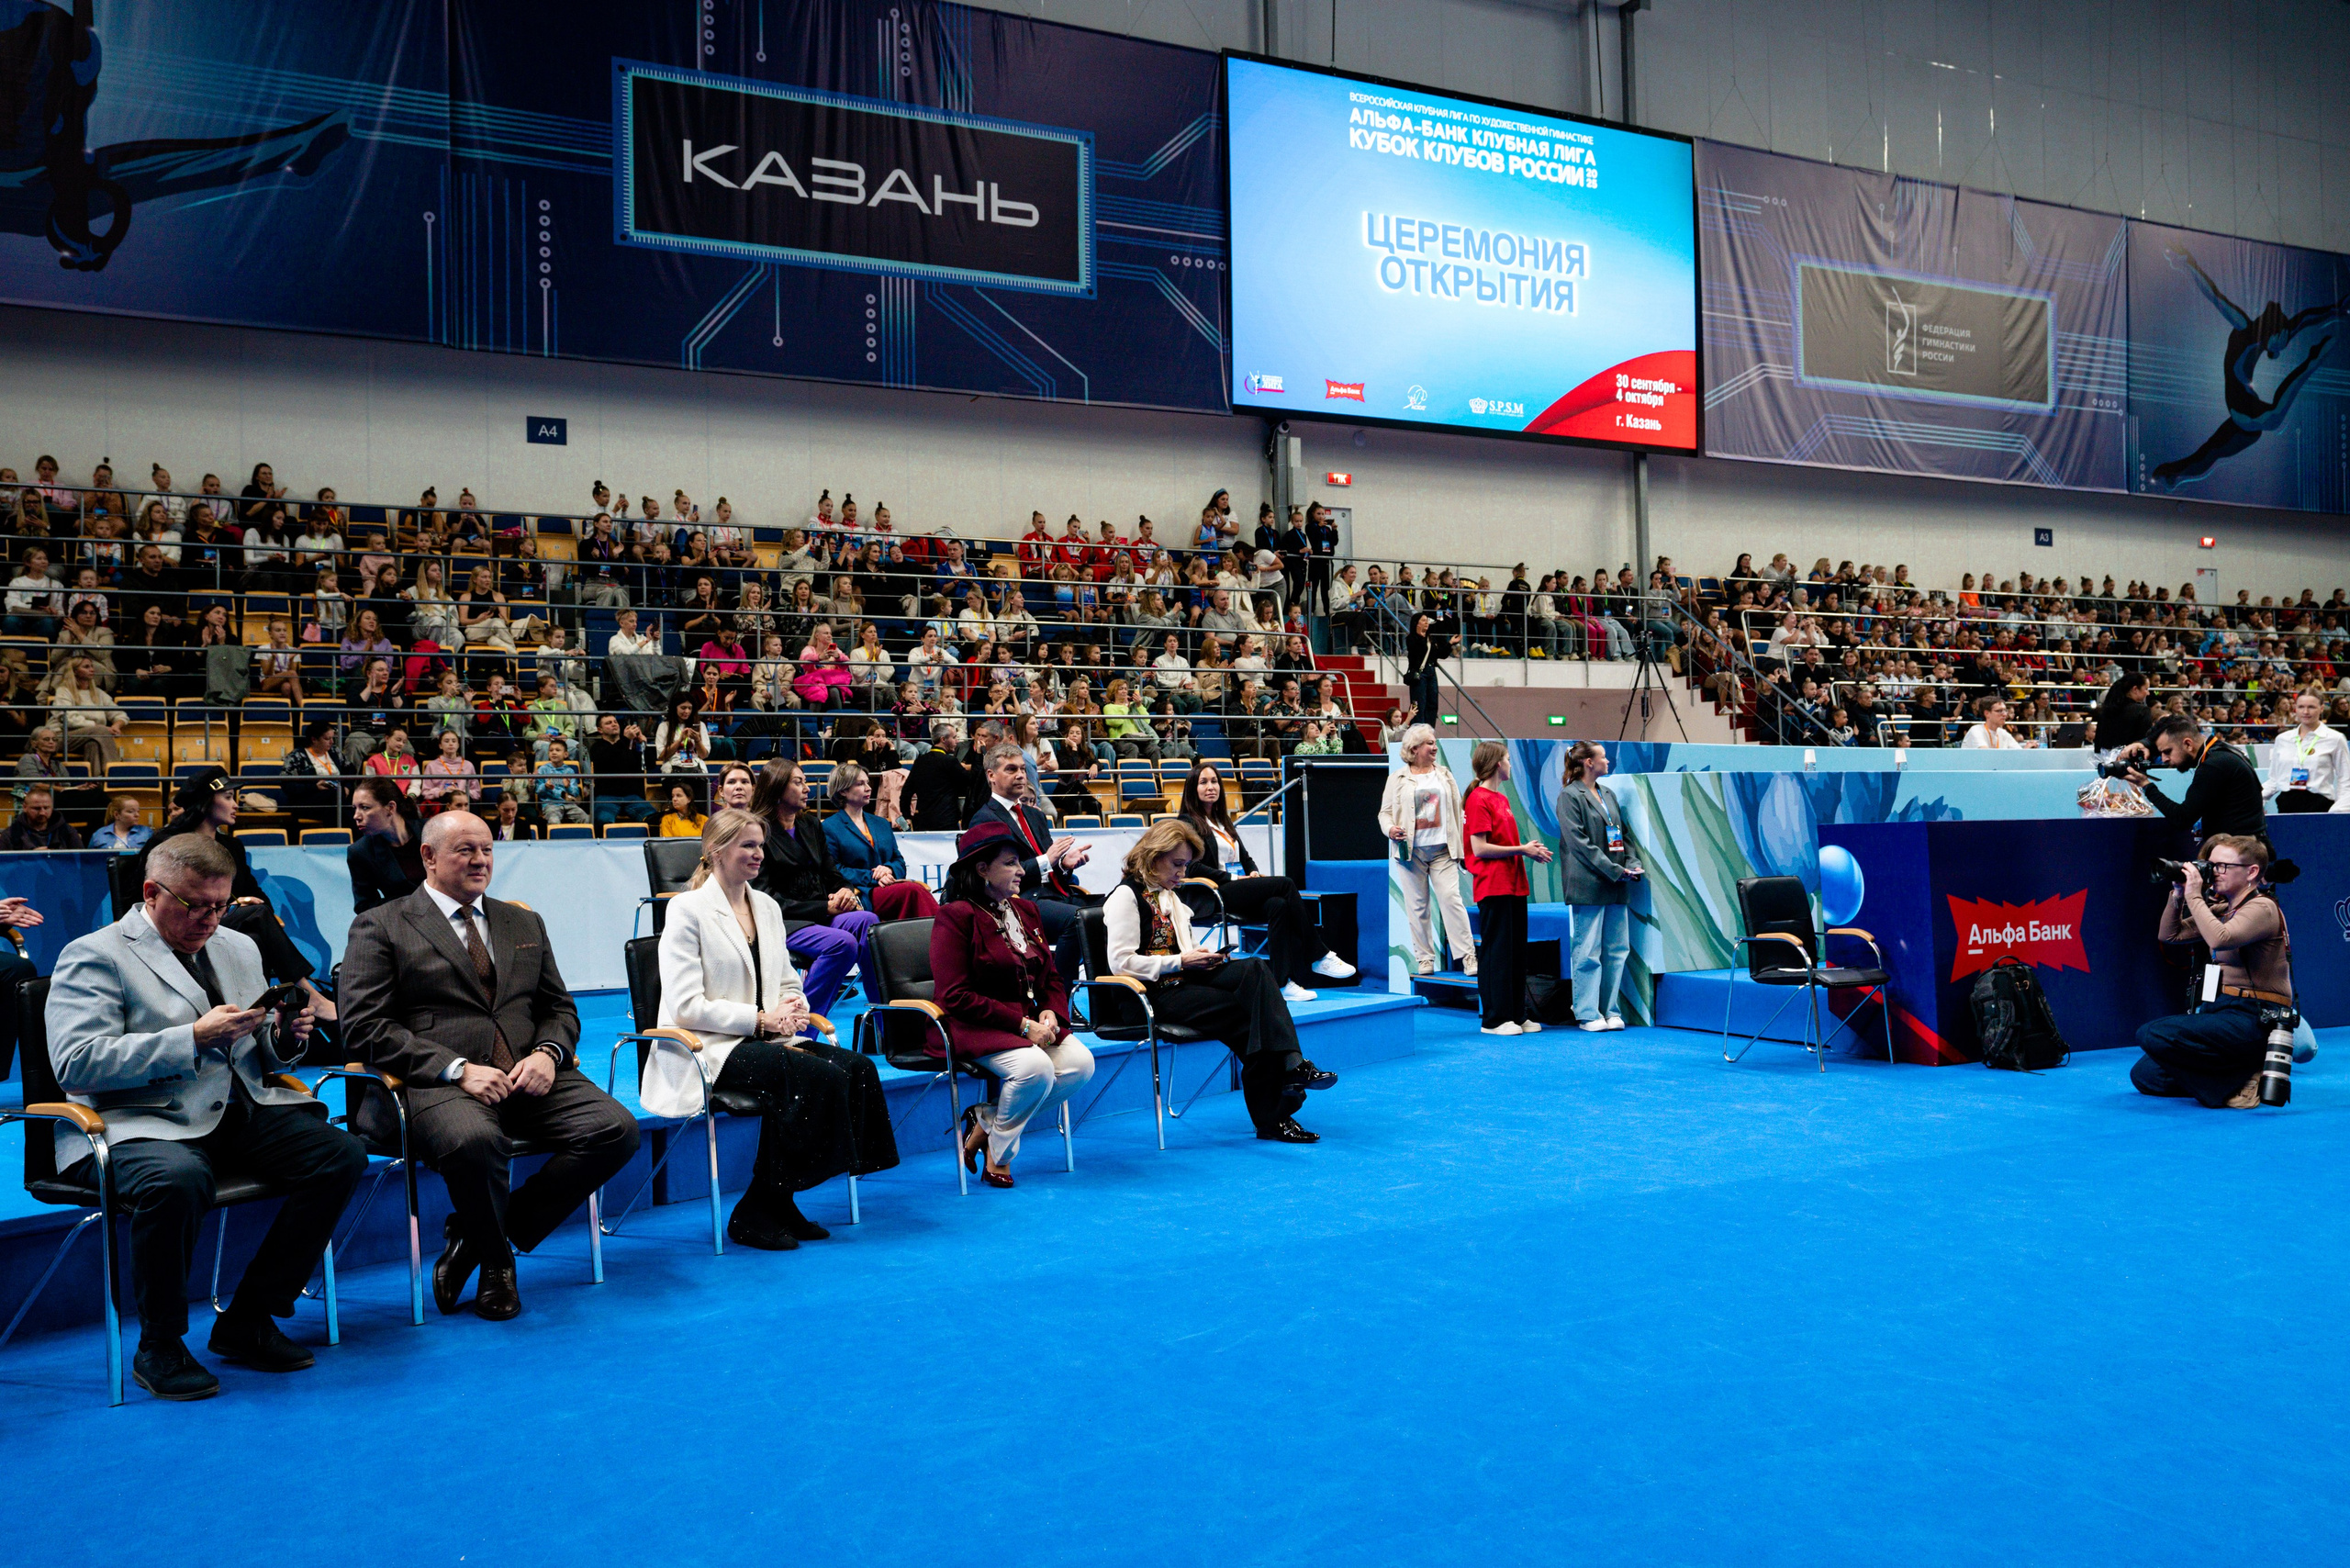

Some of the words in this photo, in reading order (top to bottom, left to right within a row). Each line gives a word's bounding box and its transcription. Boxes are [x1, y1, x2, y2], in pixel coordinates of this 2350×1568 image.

[1349, 92, 1413, 112] ВСЕРОССИЙСКАЯ
[1414, 104, 1449, 118] КЛУБНАЯ
[1449, 110, 1469, 122] ЛИГА
[1469, 114, 1481, 125] ПО
[1482, 116, 1549, 137] ХУДОЖЕСТВЕННОЙ
[1550, 129, 1595, 145] ГИМНАСТИКЕ
[1349, 107, 1468, 143] АЛЬФА-БАНК
[1472, 129, 1550, 158] КЛУБНАЯ
[1553, 143, 1596, 166] ЛИГА
[1349, 127, 1419, 159] КУБОК
[1424, 140, 1505, 174] КЛУБОВ
[1508, 154, 1584, 187] РОССИИ
[1585, 167, 1598, 178] 20
[682, 139, 1040, 228] КАЗАНЬ
[1585, 178, 1598, 189] 25
[1365, 211, 1587, 278] ЦЕРЕМОНИЯ
[1379, 254, 1576, 314] ОТКРЫТИЯ
[1922, 324, 1971, 338] ФЕДЕРАЦИЯ
[1922, 338, 1975, 353] ГИМНАСТИКИ
[1922, 351, 1954, 363] РОССИИ
[1616, 374, 1628, 388] 30
[1631, 378, 1675, 396] сентября
[1489, 400, 1524, 414] S.P.S.M
[1616, 388, 1623, 401] 4
[1625, 392, 1663, 409] октября
[1616, 415, 1624, 427] г.
[1626, 414, 1662, 431] Казань
[1967, 922, 2026, 949] Альфа
[2029, 920, 2072, 942] Банк
